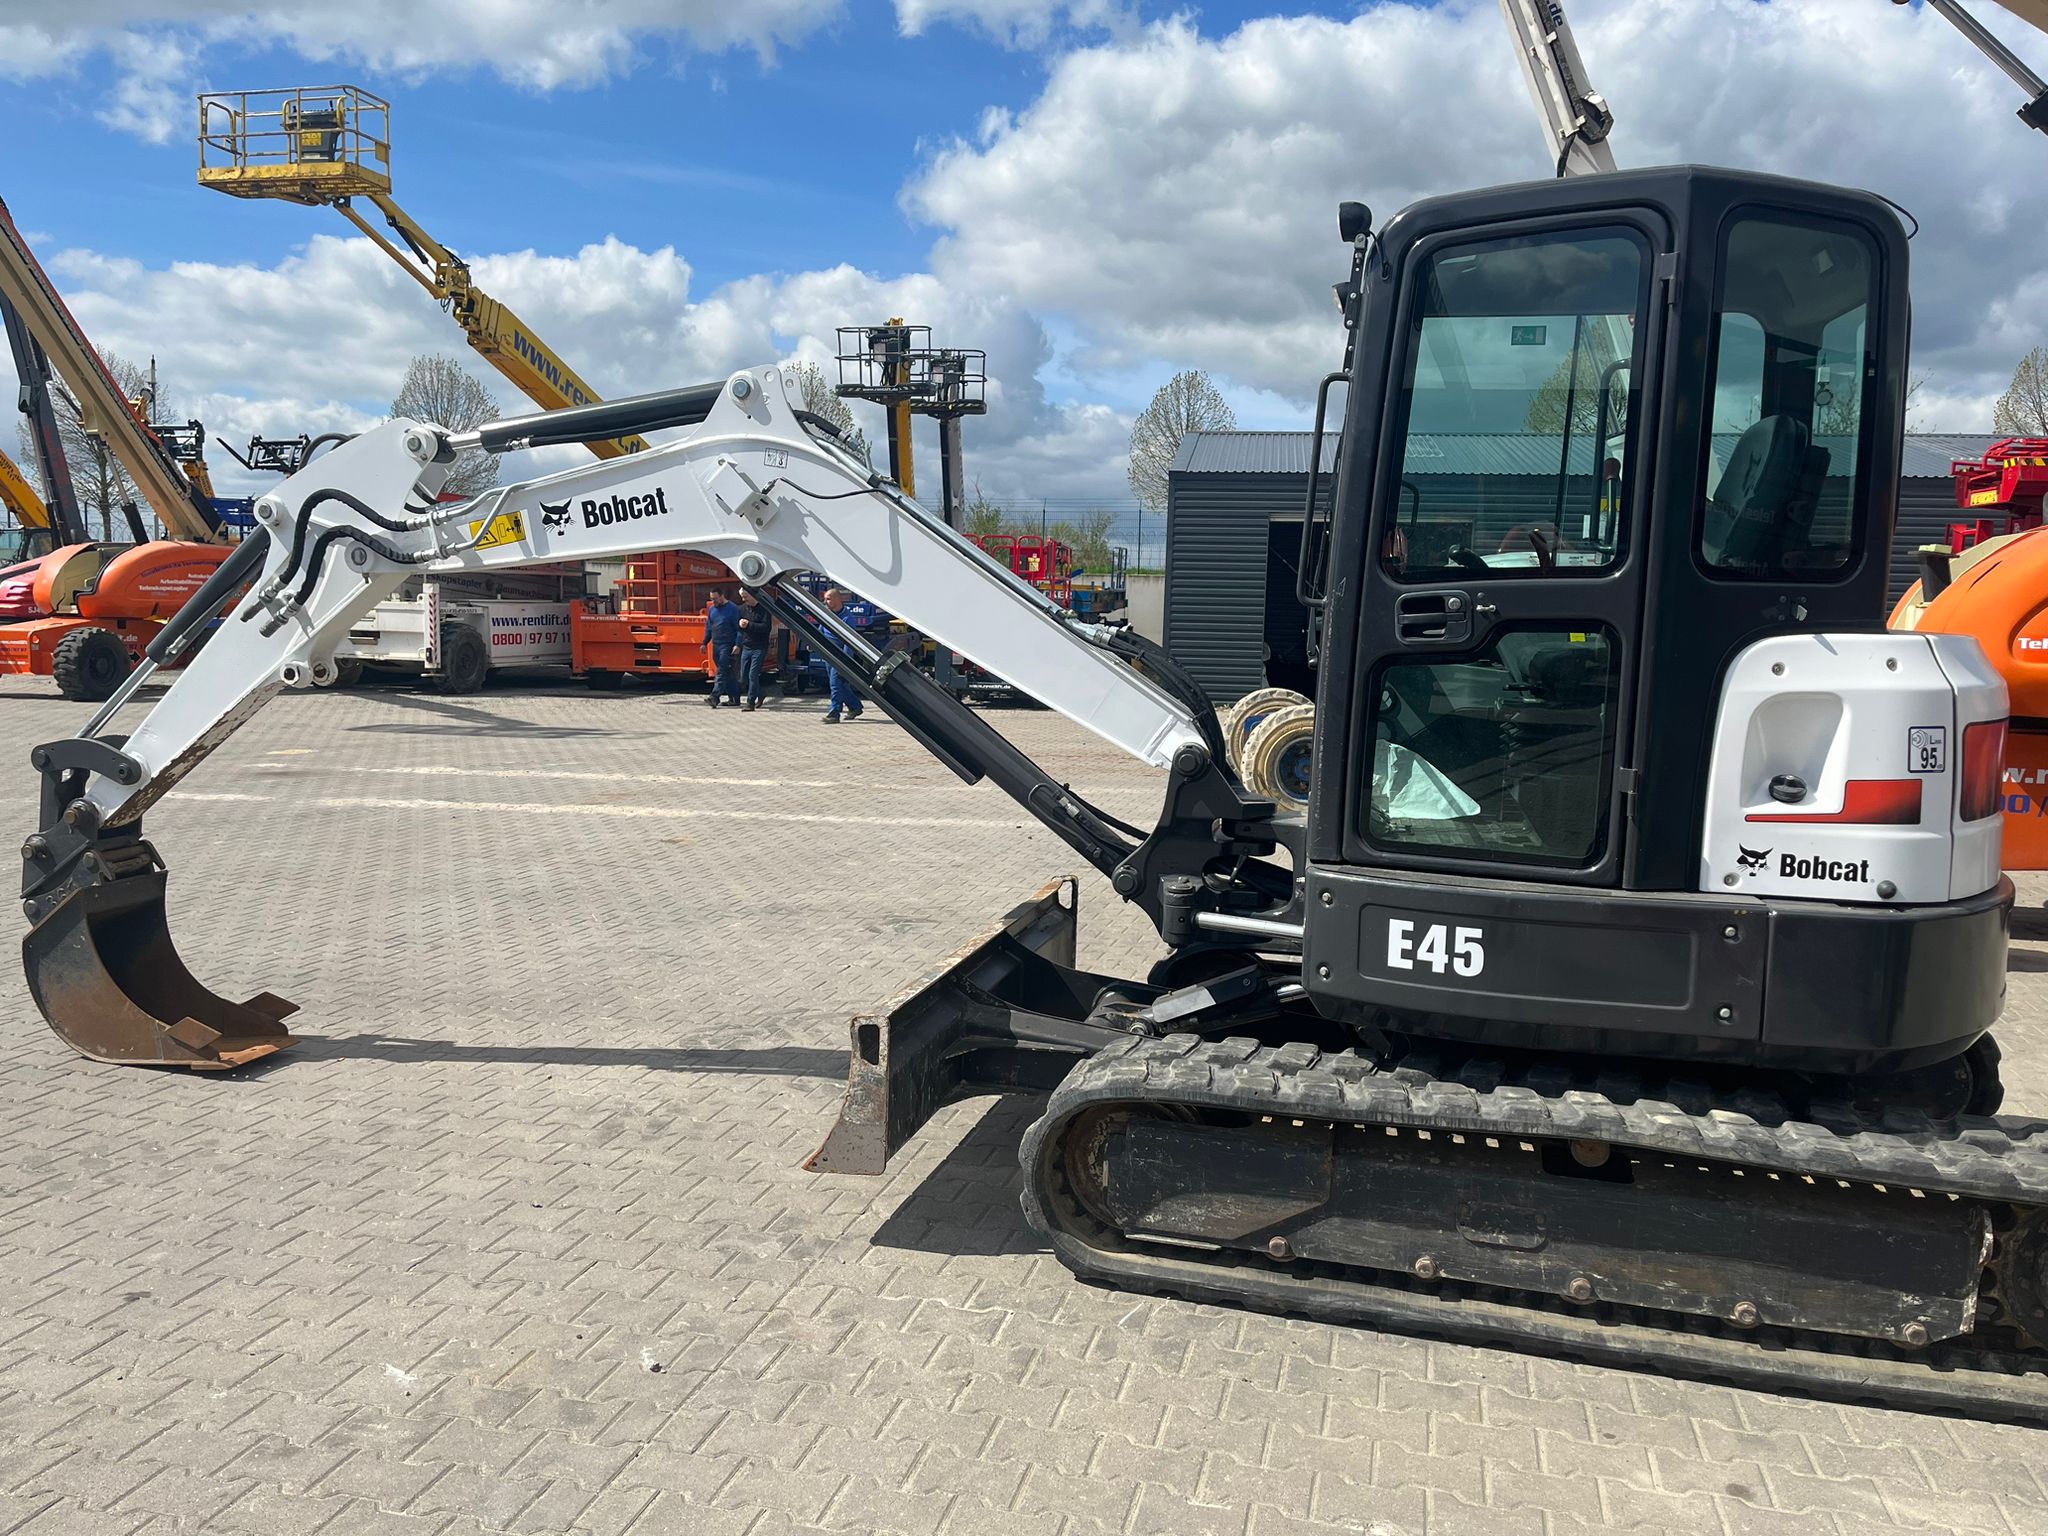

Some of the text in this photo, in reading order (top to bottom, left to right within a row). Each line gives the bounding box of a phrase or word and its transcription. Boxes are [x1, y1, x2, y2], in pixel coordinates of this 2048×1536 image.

[581, 487, 667, 528] Bobcat
[491, 614, 571, 627] www.rentlift.d
[492, 633, 523, 645] 0800
[529, 633, 542, 644] 97
[545, 632, 558, 644] 97
[1921, 747, 1938, 769] 95
[1779, 853, 1869, 883] Bobcat
[1387, 918, 1484, 977] E45
